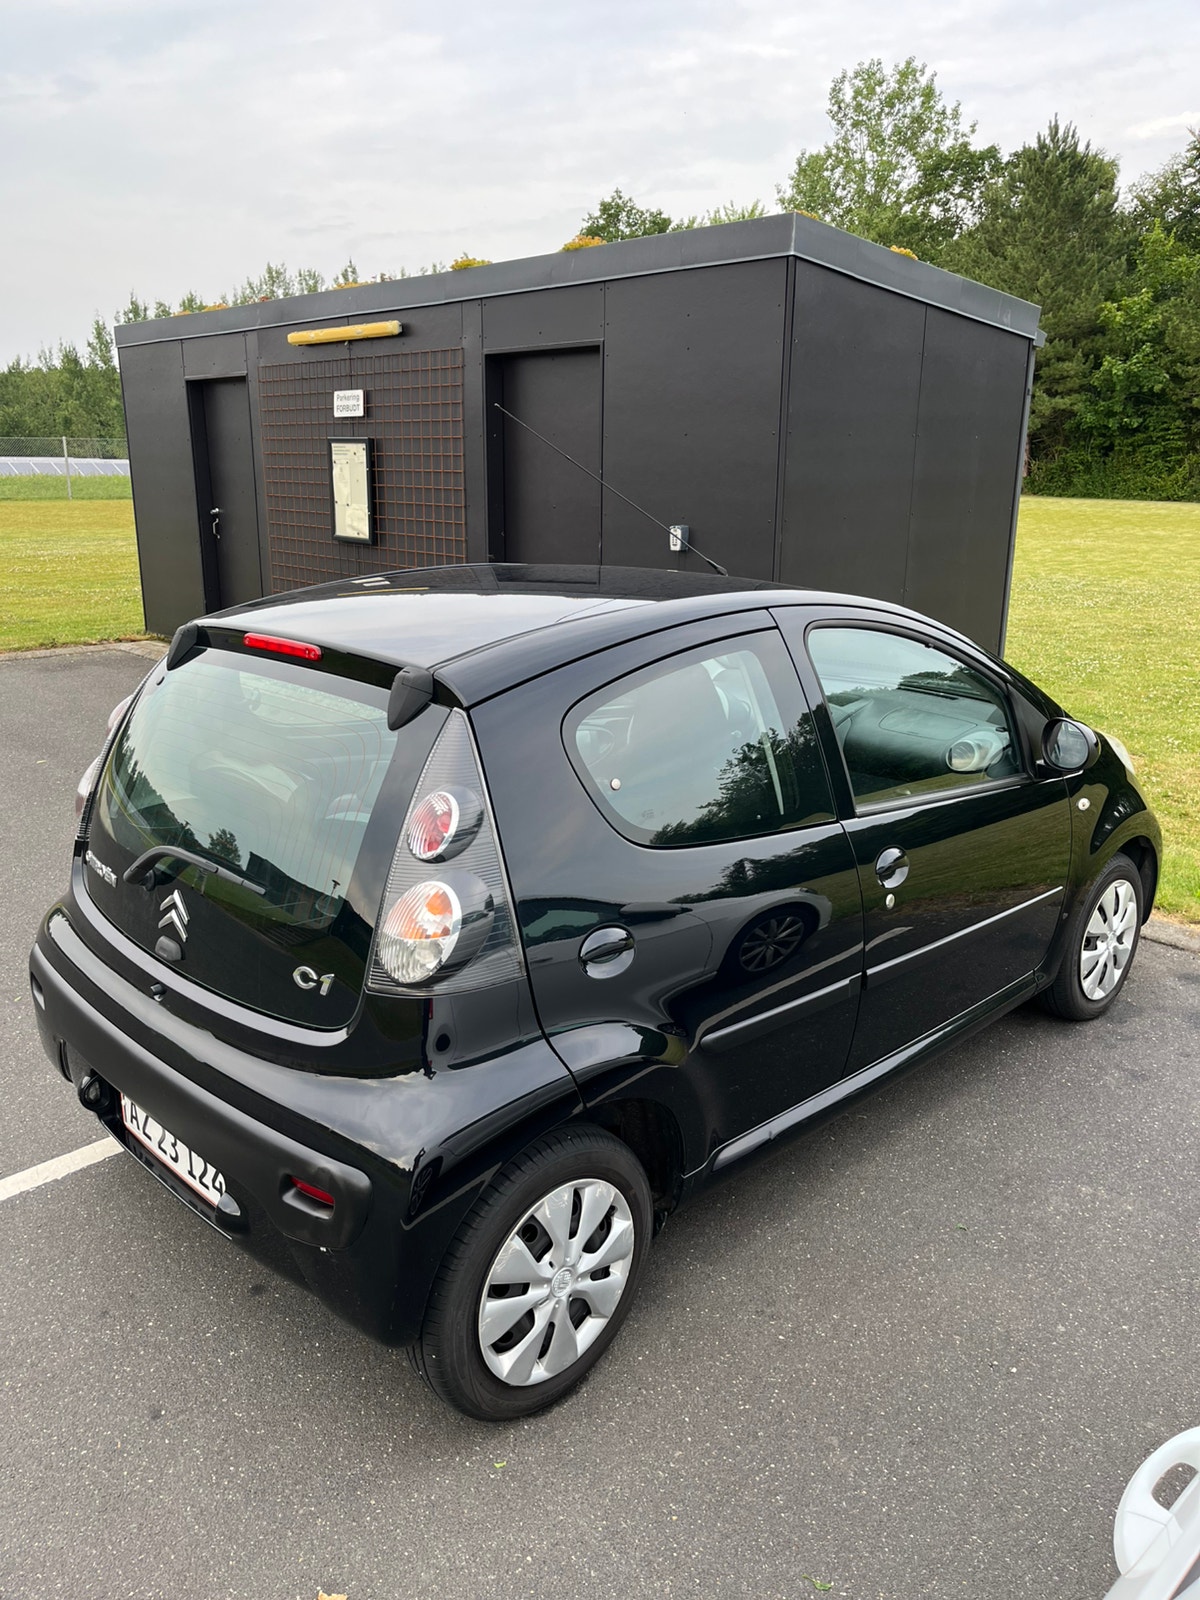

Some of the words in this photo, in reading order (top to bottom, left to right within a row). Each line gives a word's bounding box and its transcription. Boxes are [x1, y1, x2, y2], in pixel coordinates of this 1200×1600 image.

[336, 394, 360, 402] Parkering
[336, 404, 360, 412] FORBUDT
[293, 966, 335, 996] C1
